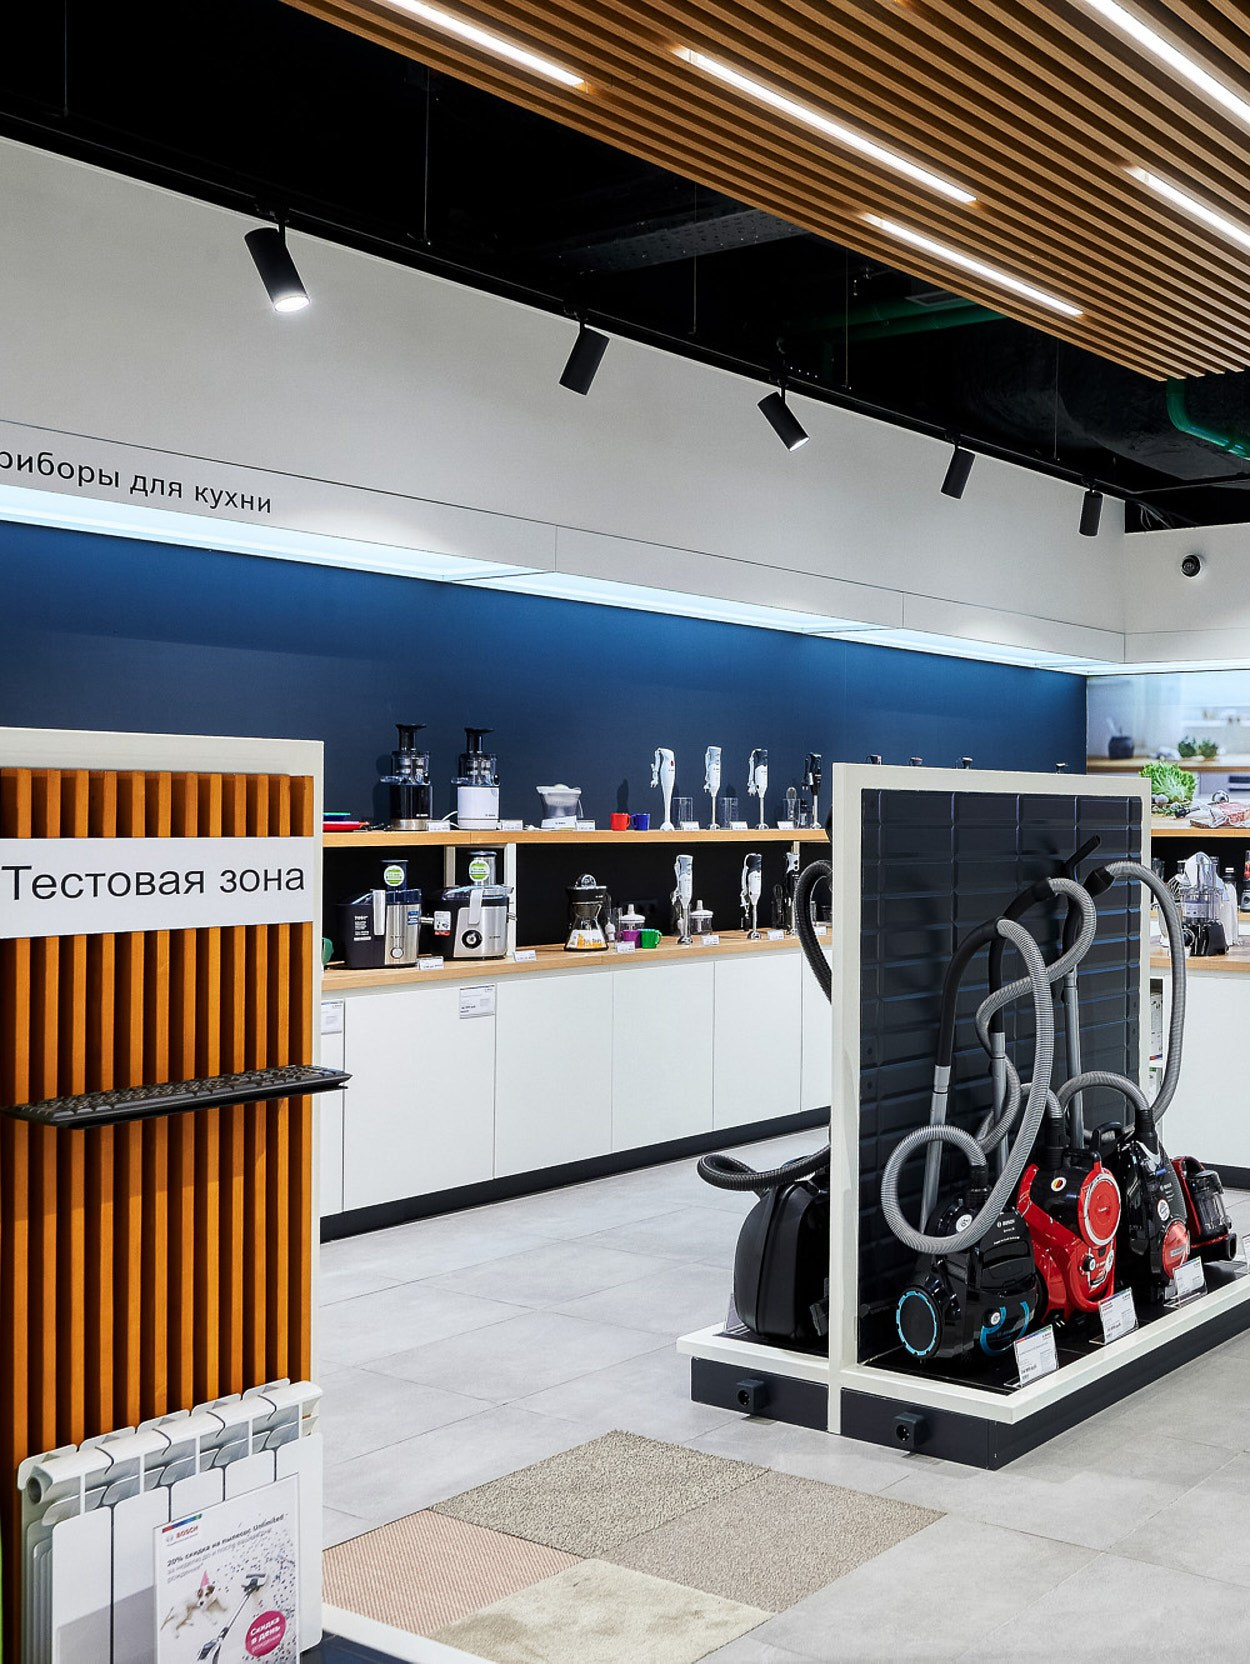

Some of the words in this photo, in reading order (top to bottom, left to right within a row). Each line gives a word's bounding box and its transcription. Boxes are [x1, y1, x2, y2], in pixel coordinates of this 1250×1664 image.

[129, 474, 183, 499] для
[194, 485, 272, 513] кухни
[1, 865, 206, 900] Тестовая
[219, 867, 305, 894] зона
[175, 1525, 199, 1539] BOSCH
[185, 1545, 210, 1560] скидка
[222, 1528, 251, 1544] пылесос
[253, 1513, 284, 1531] Unlimited
[250, 1616, 280, 1636] Скидка
